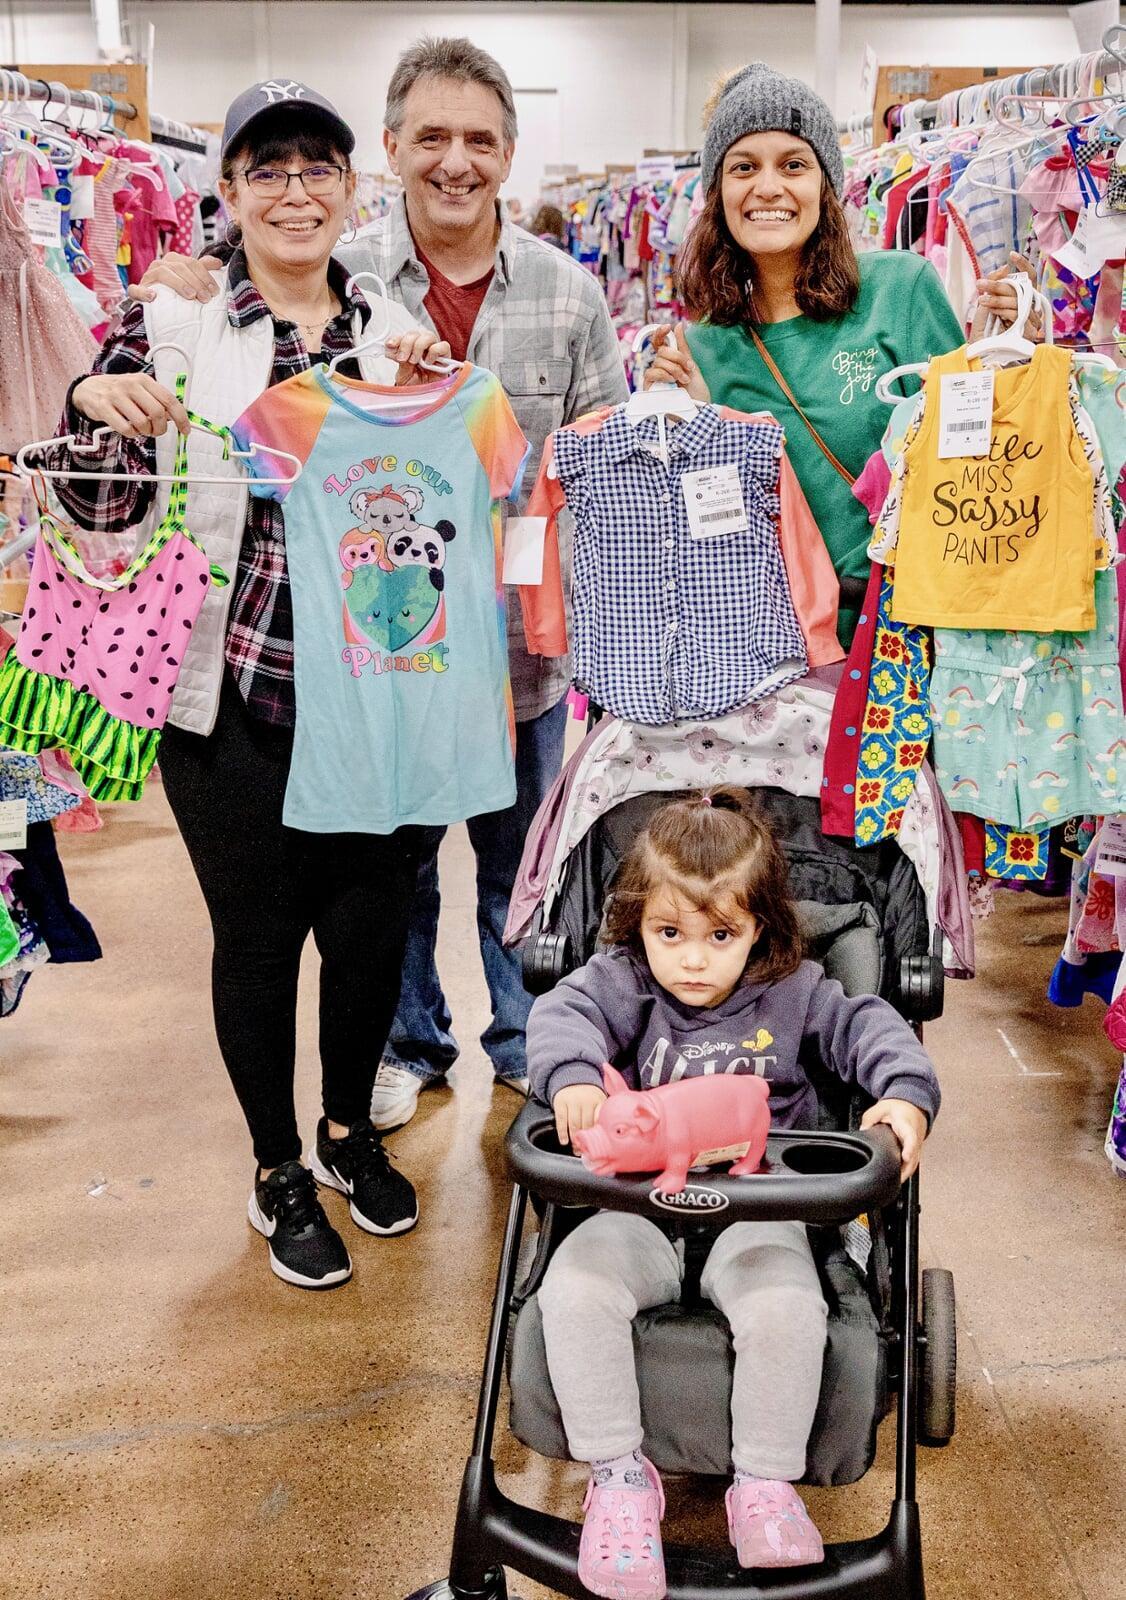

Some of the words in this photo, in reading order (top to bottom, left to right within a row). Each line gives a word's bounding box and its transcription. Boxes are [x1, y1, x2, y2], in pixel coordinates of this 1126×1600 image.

[832, 348, 878, 376] Bring
[840, 371, 877, 405] joy
[322, 455, 398, 497] Love
[405, 459, 454, 497] our
[961, 463, 1015, 493] MISS
[932, 480, 1048, 538] Sassy
[942, 532, 1021, 566] PANTS
[341, 642, 450, 679] Planet
[660, 1191, 721, 1208] GRACO
